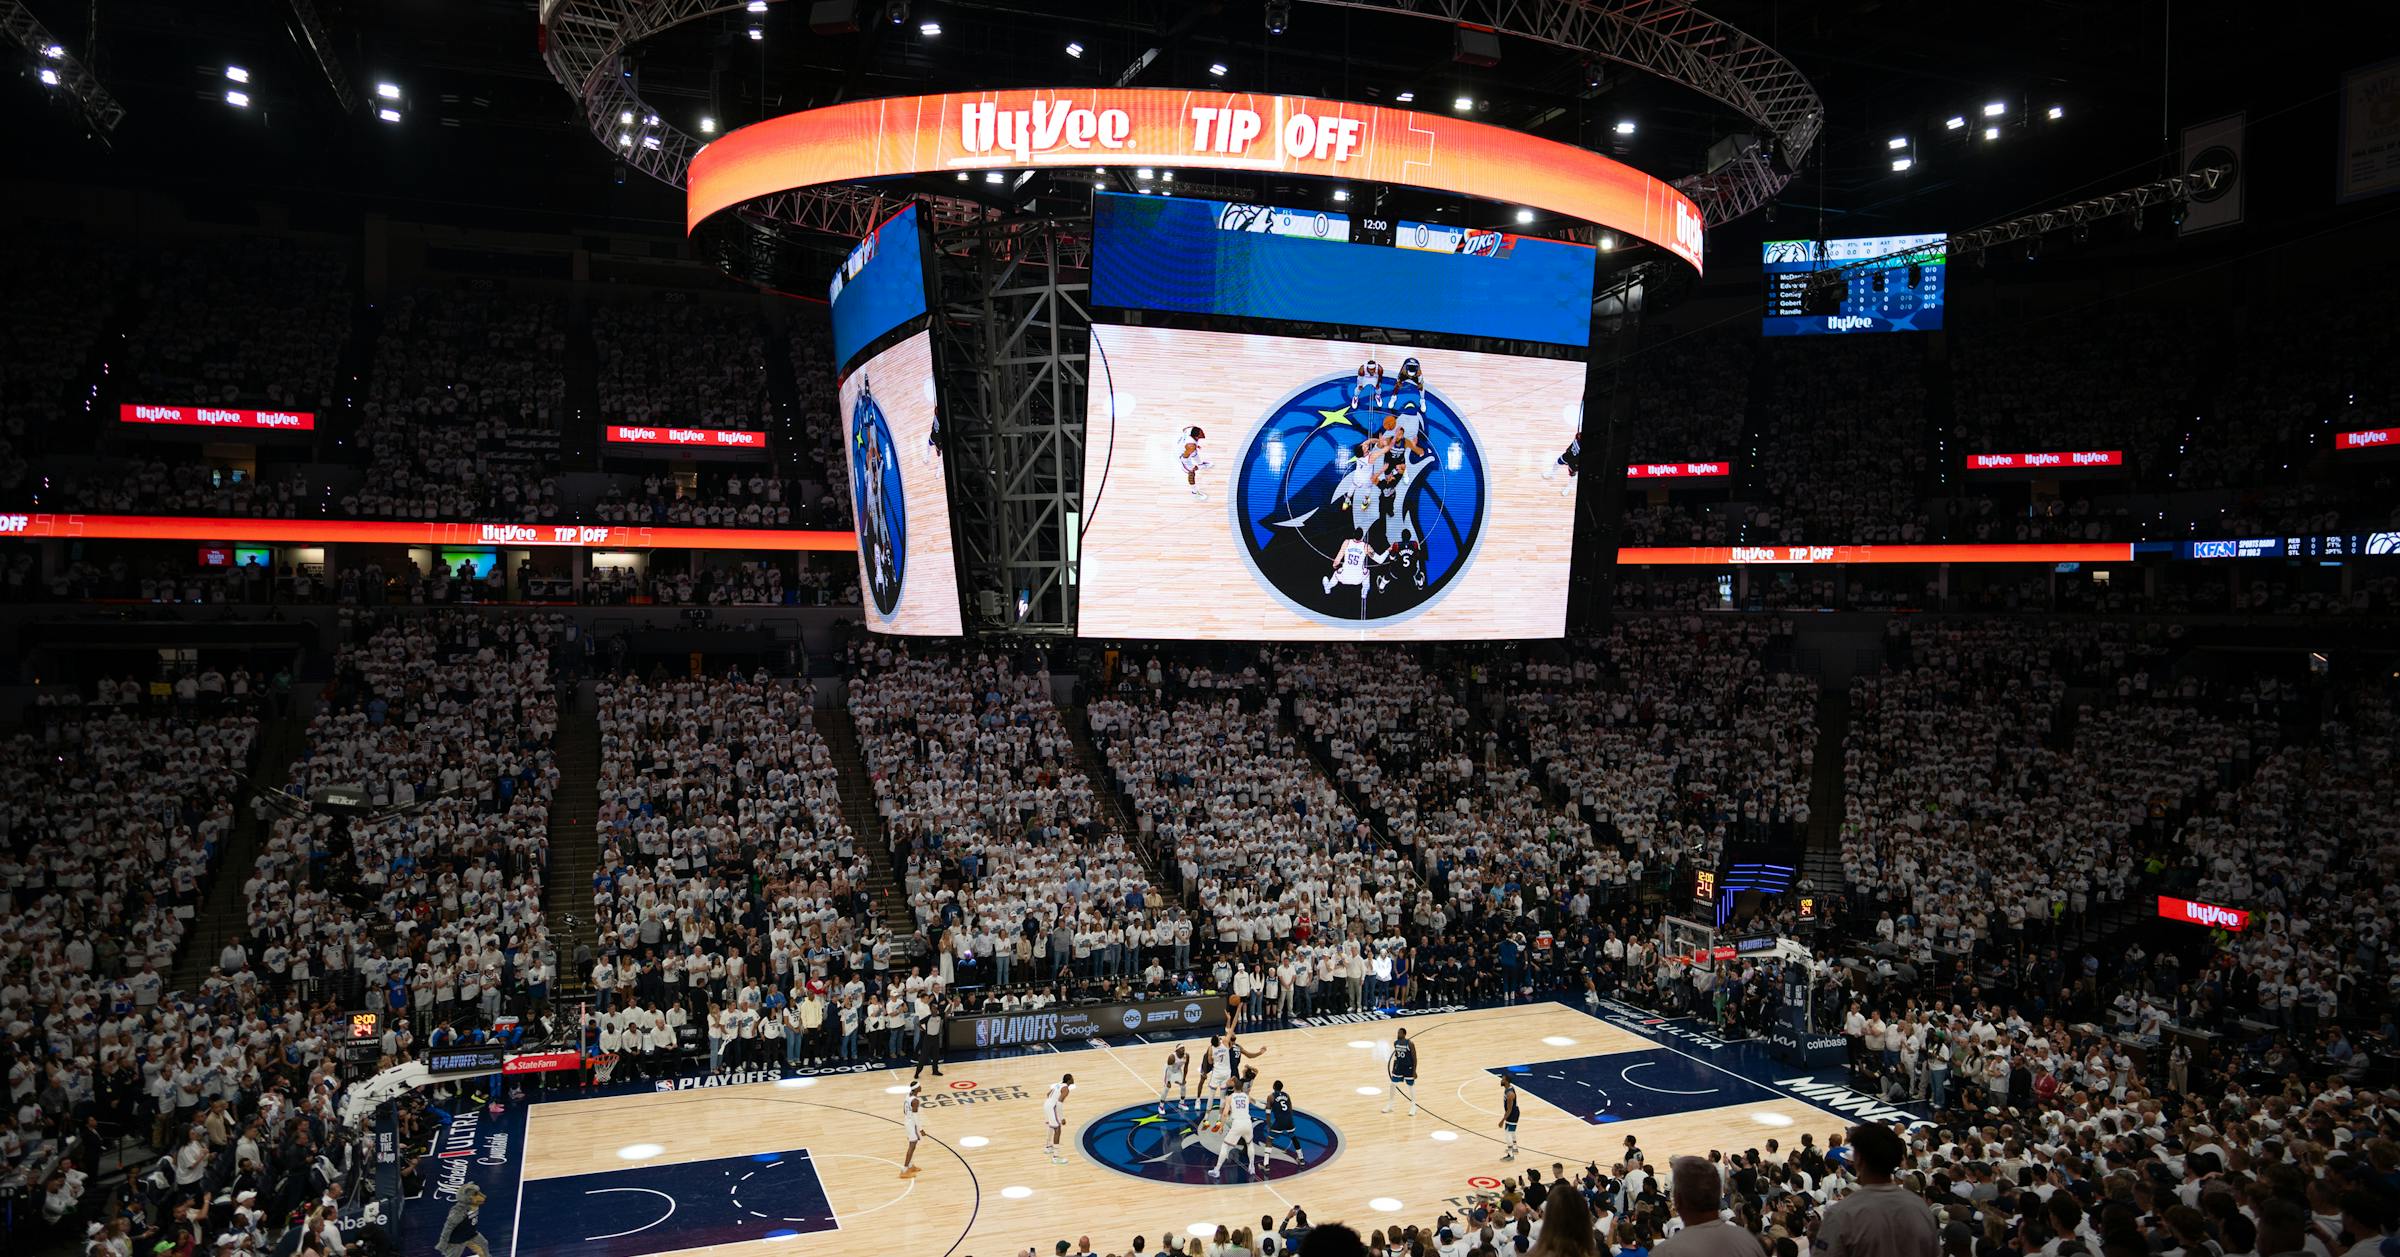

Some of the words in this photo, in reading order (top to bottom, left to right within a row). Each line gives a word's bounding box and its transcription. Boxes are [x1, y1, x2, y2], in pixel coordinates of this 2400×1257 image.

[962, 100, 1130, 161] HyVee
[1191, 106, 1261, 154] TIP
[1284, 114, 1359, 163] OFF
[1312, 213, 1329, 237] 0
[1363, 219, 1387, 231] 12:00
[1414, 224, 1429, 248] 0
[1465, 232, 1494, 255] OKC
[1828, 315, 1872, 331] HyVee
[136, 406, 181, 422] HyVee
[197, 409, 240, 424] HyVee
[256, 412, 299, 427] HyVee
[619, 427, 655, 441] HyVee
[669, 430, 705, 443] HyVee
[718, 432, 753, 444] HyVee
[482, 525, 537, 544] HyVee
[554, 528, 576, 541] TIP
[583, 528, 608, 543] OFF
[1732, 547, 1774, 562] HyVee
[1789, 548, 1807, 560] TIP
[1813, 547, 1834, 560] OFF
[2194, 541, 2236, 559] KFAN
[1347, 554, 1360, 566] 55
[1402, 555, 1411, 568] 5
[1699, 870, 1714, 883] 12:00
[1697, 881, 1713, 900] 24
[1801, 906, 1811, 915] 24
[2186, 901, 2238, 925] HyVee
[353, 1014, 376, 1025] 12:00
[1306, 1010, 1392, 1027] PLAYOFFS
[1396, 1004, 1468, 1016] Google
[354, 1024, 372, 1037] 24
[990, 1013, 1057, 1046] PLAYOFFS
[1147, 1010, 1178, 1022] ESPN
[1184, 1009, 1202, 1019] TNT
[1061, 1021, 1100, 1036] Google
[1656, 1023, 1723, 1050] ULTRA
[1807, 1038, 1847, 1050] coinbase
[440, 1054, 478, 1069] PLAYOFFS
[678, 1069, 782, 1090] PLAYOFFS
[796, 1060, 886, 1076] Google
[919, 1085, 1022, 1102] TARGET
[919, 1091, 1030, 1109] CENTER
[1235, 1099, 1246, 1109] 55
[1280, 1100, 1288, 1111] 5
[380, 1133, 392, 1143] GET
[446, 1110, 480, 1150] ULTRA
[380, 1141, 393, 1152] THE
